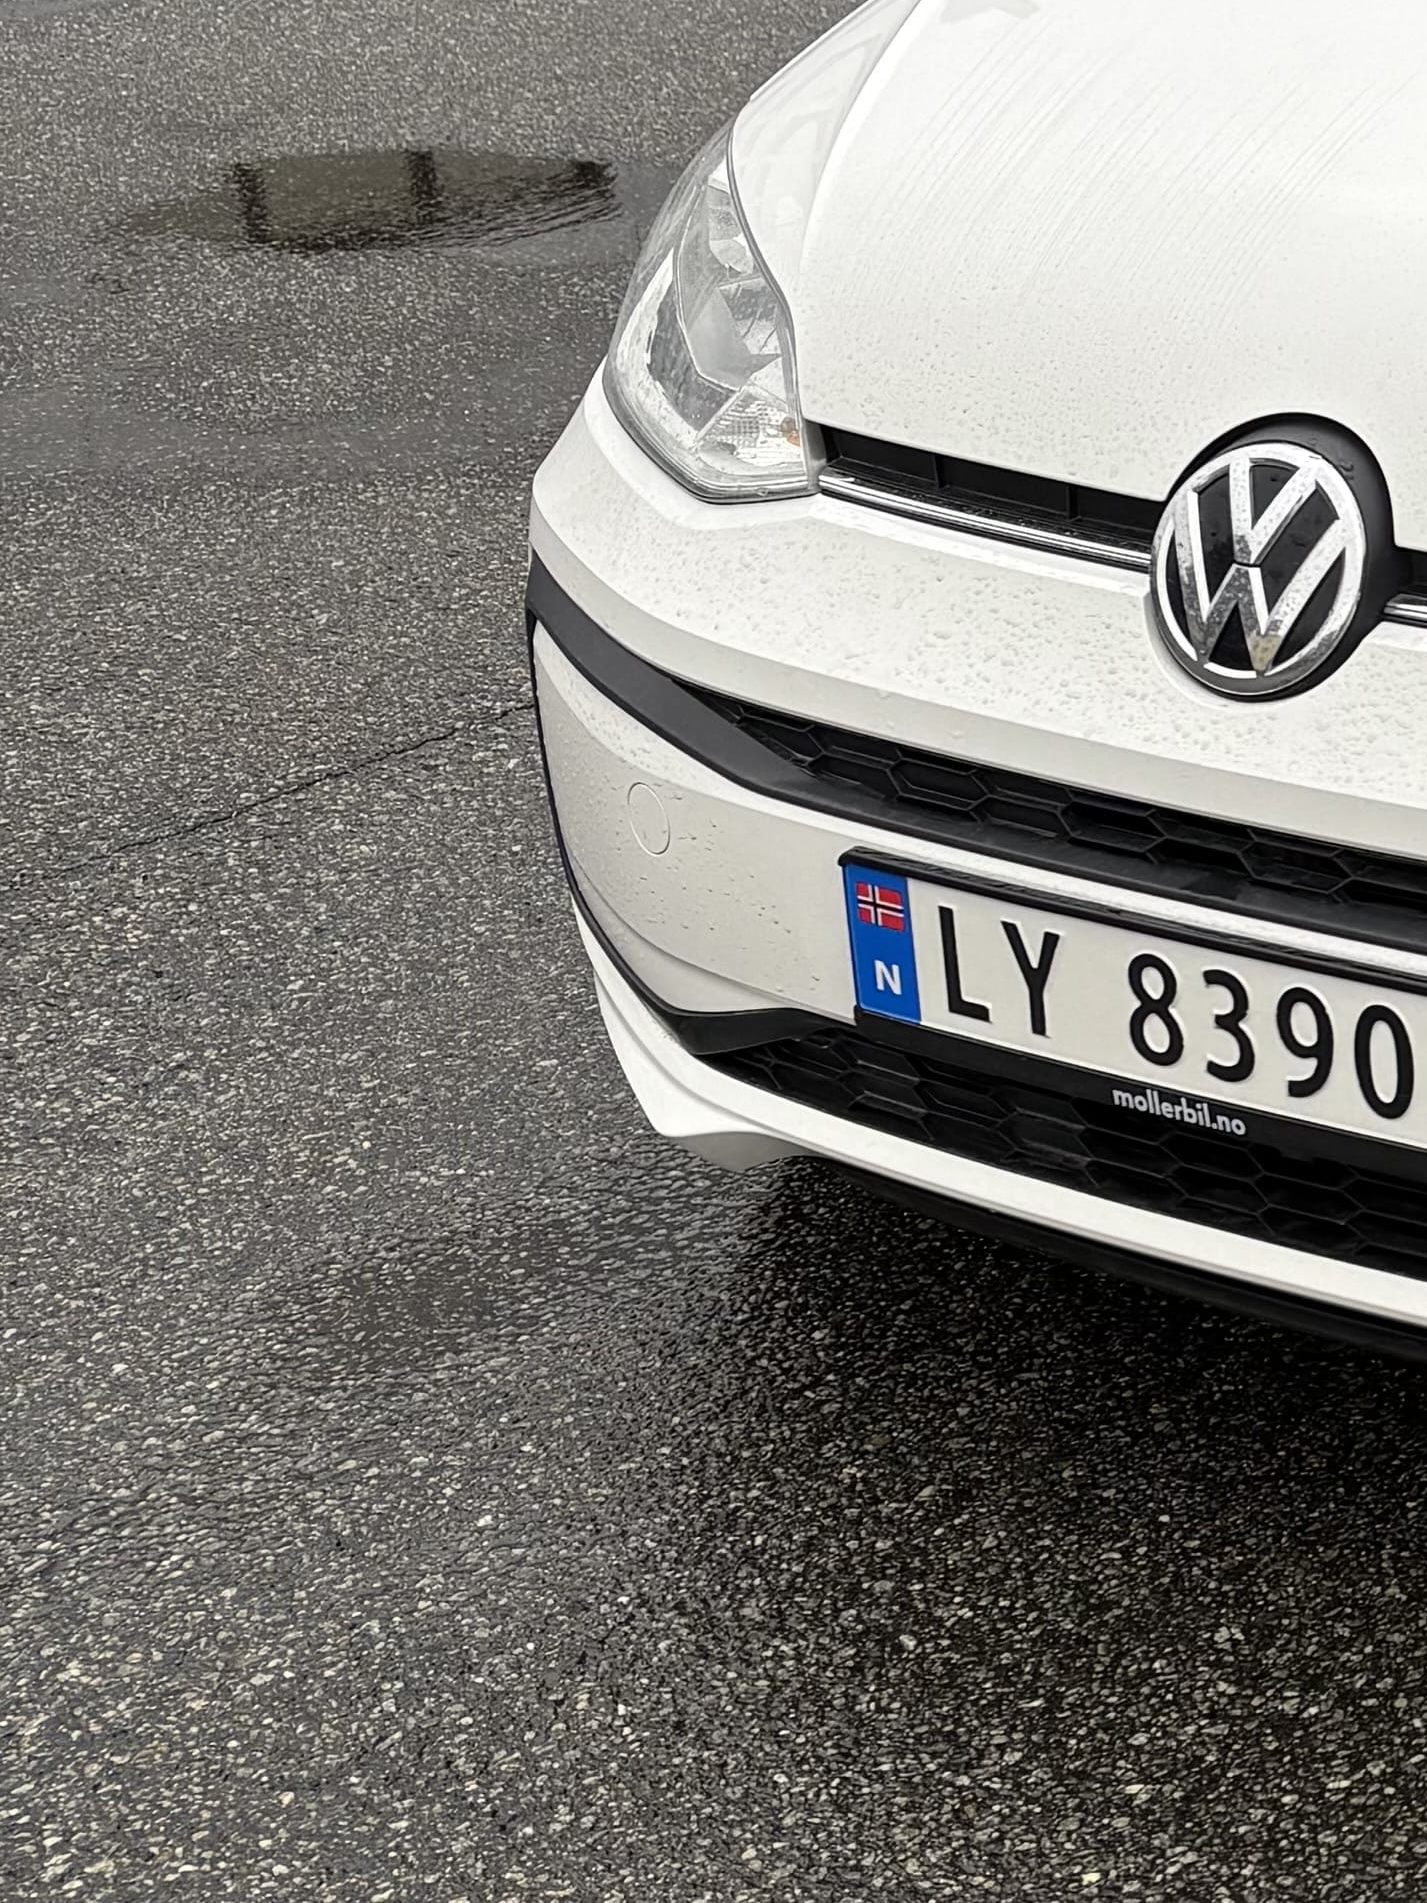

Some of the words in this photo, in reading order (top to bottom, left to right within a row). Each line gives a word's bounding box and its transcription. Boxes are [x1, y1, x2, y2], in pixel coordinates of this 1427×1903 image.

[874, 959, 902, 996] N
[937, 904, 1061, 1039] LY
[1112, 1088, 1247, 1136] mollerbil.no
